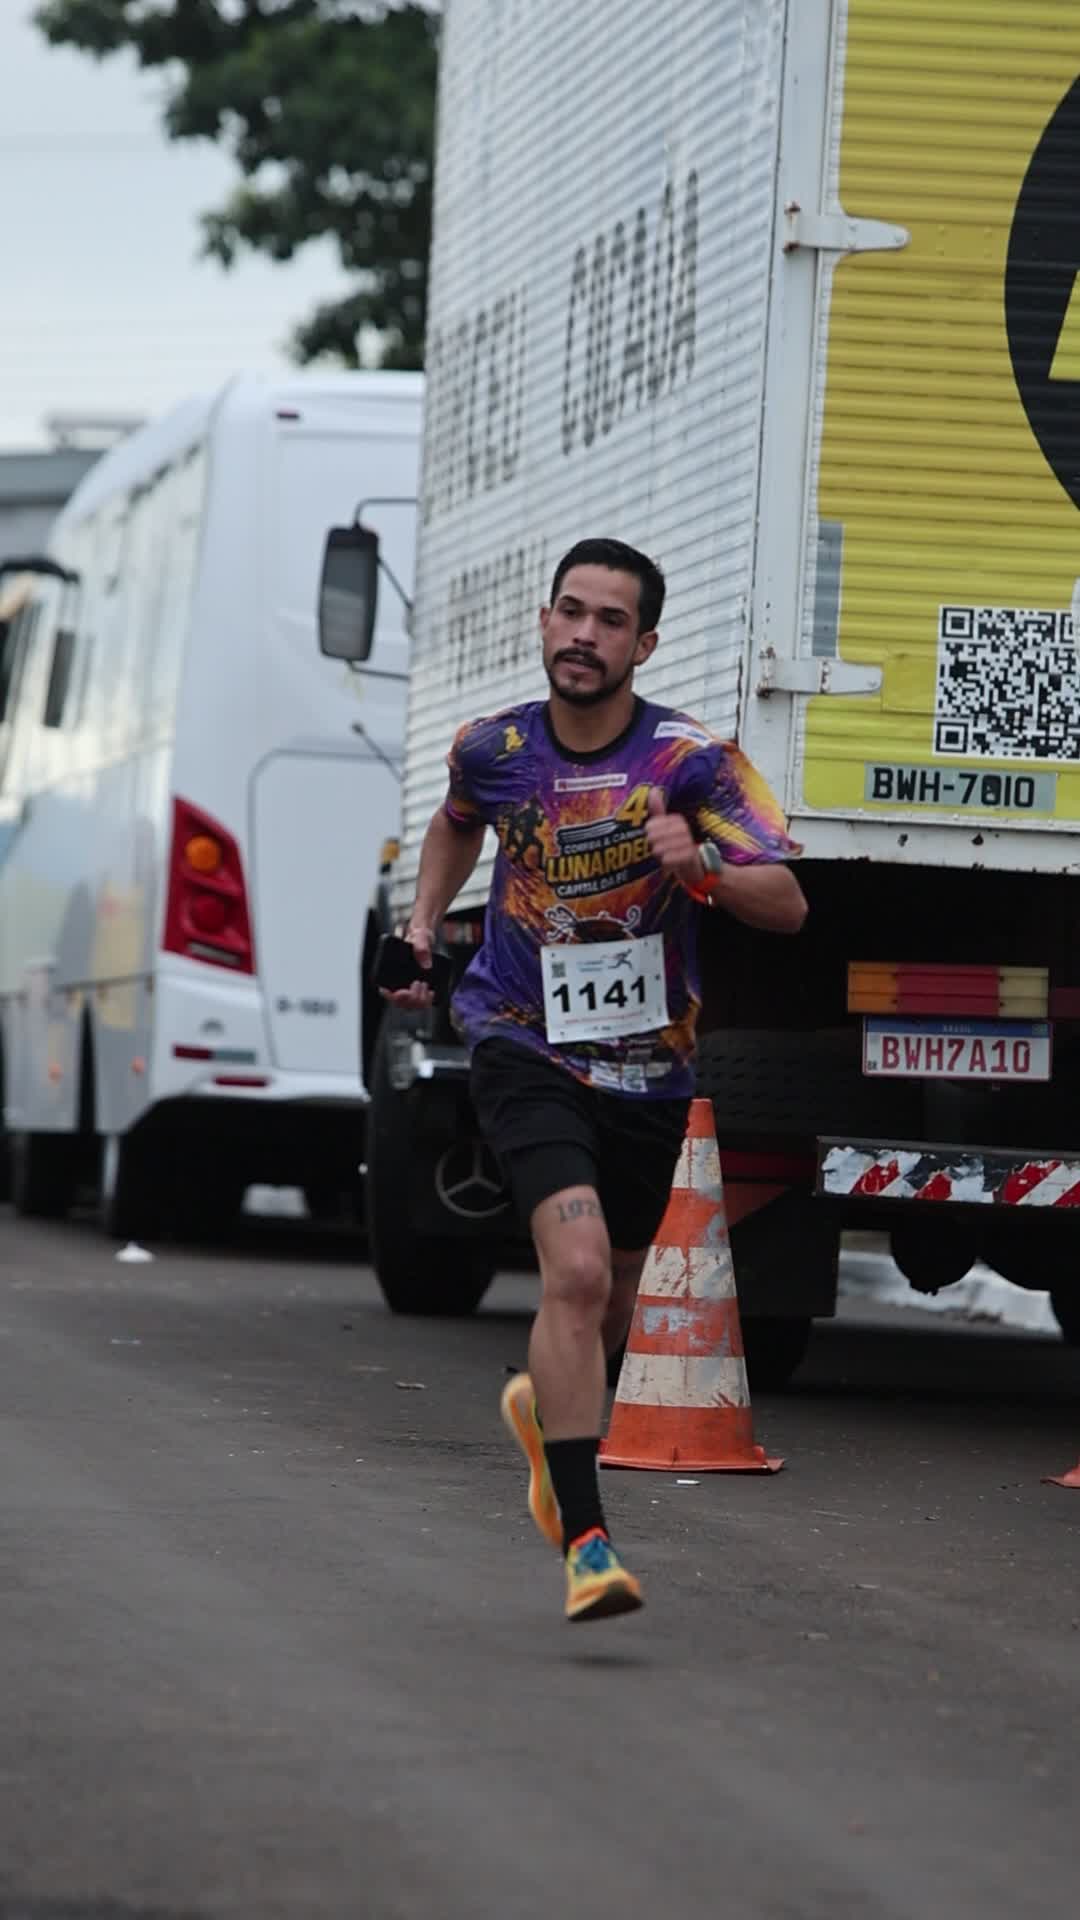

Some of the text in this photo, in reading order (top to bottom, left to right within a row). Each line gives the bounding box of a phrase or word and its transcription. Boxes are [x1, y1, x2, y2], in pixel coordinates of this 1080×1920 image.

[547, 836, 651, 882] LUNARDEL
[552, 975, 647, 1014] 1141
[882, 1035, 1031, 1074] BWH7A10
